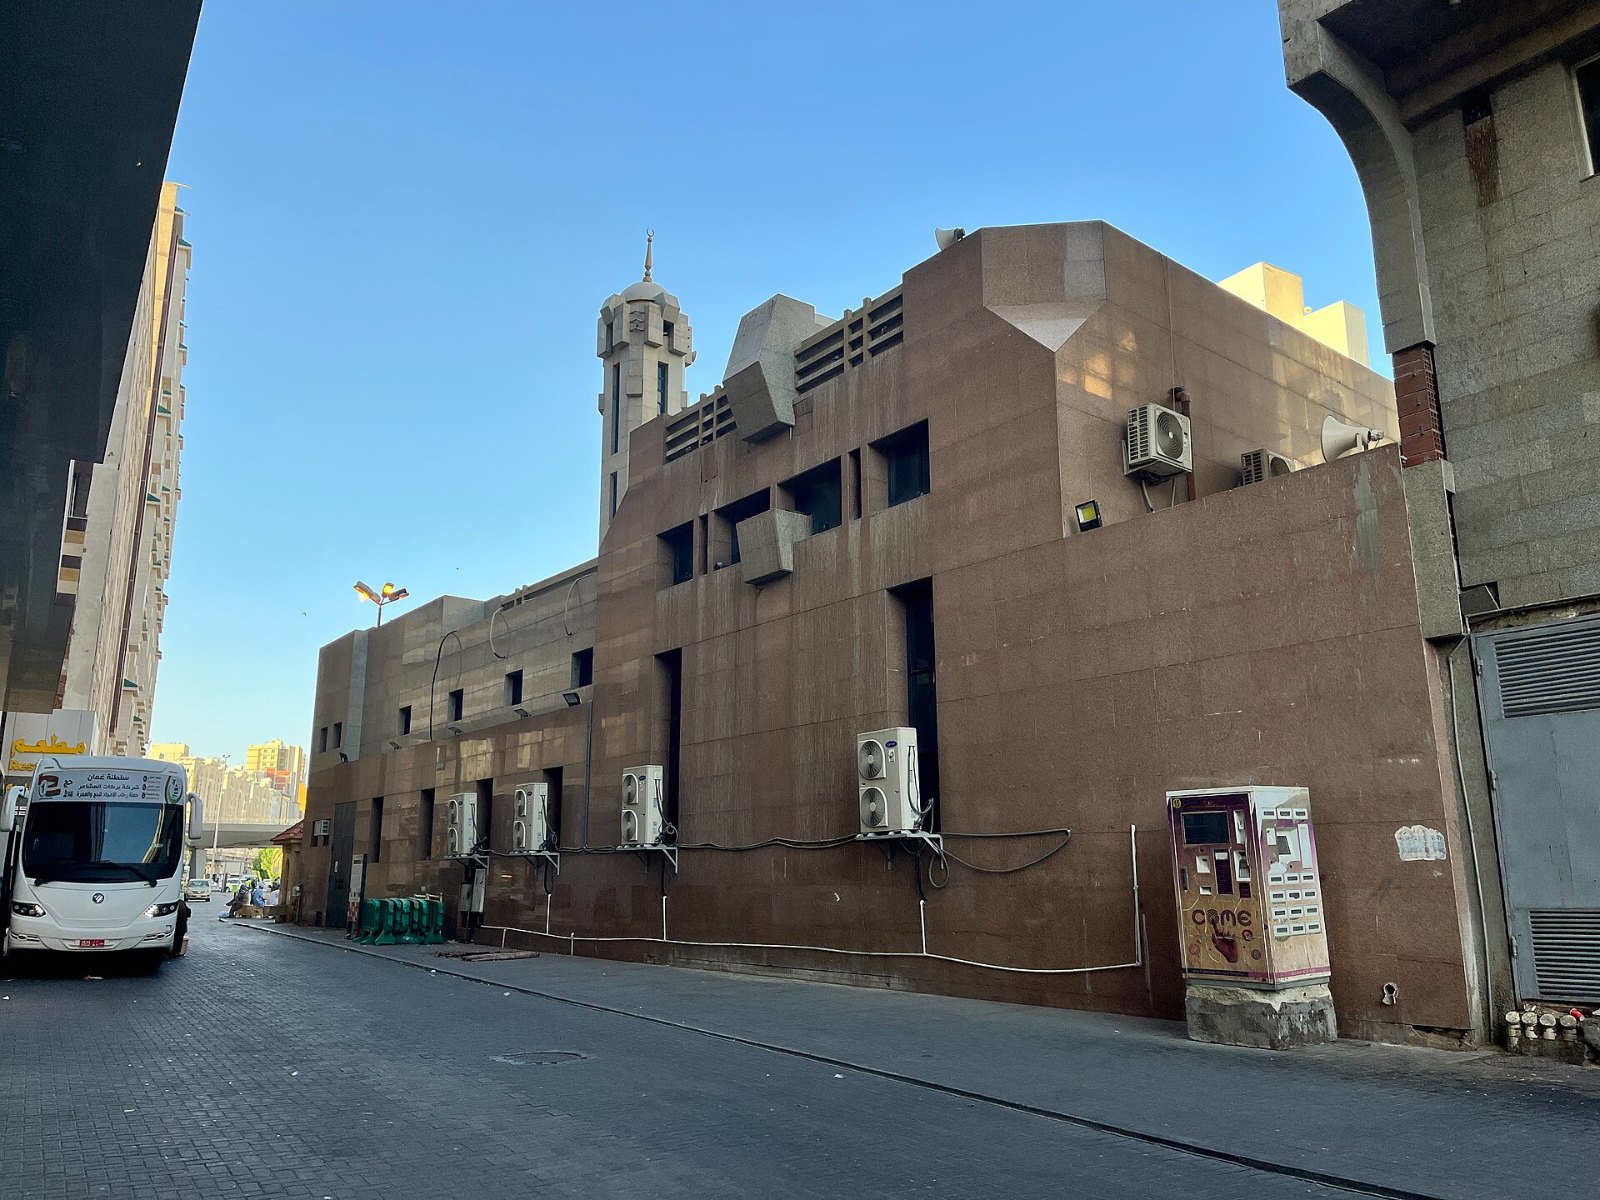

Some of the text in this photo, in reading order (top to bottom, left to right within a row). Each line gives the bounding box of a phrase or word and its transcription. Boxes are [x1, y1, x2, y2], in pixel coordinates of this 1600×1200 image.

[11, 734, 86, 759] مطعم
[9, 760, 37, 771] Res
[106, 773, 129, 781] سلطنة
